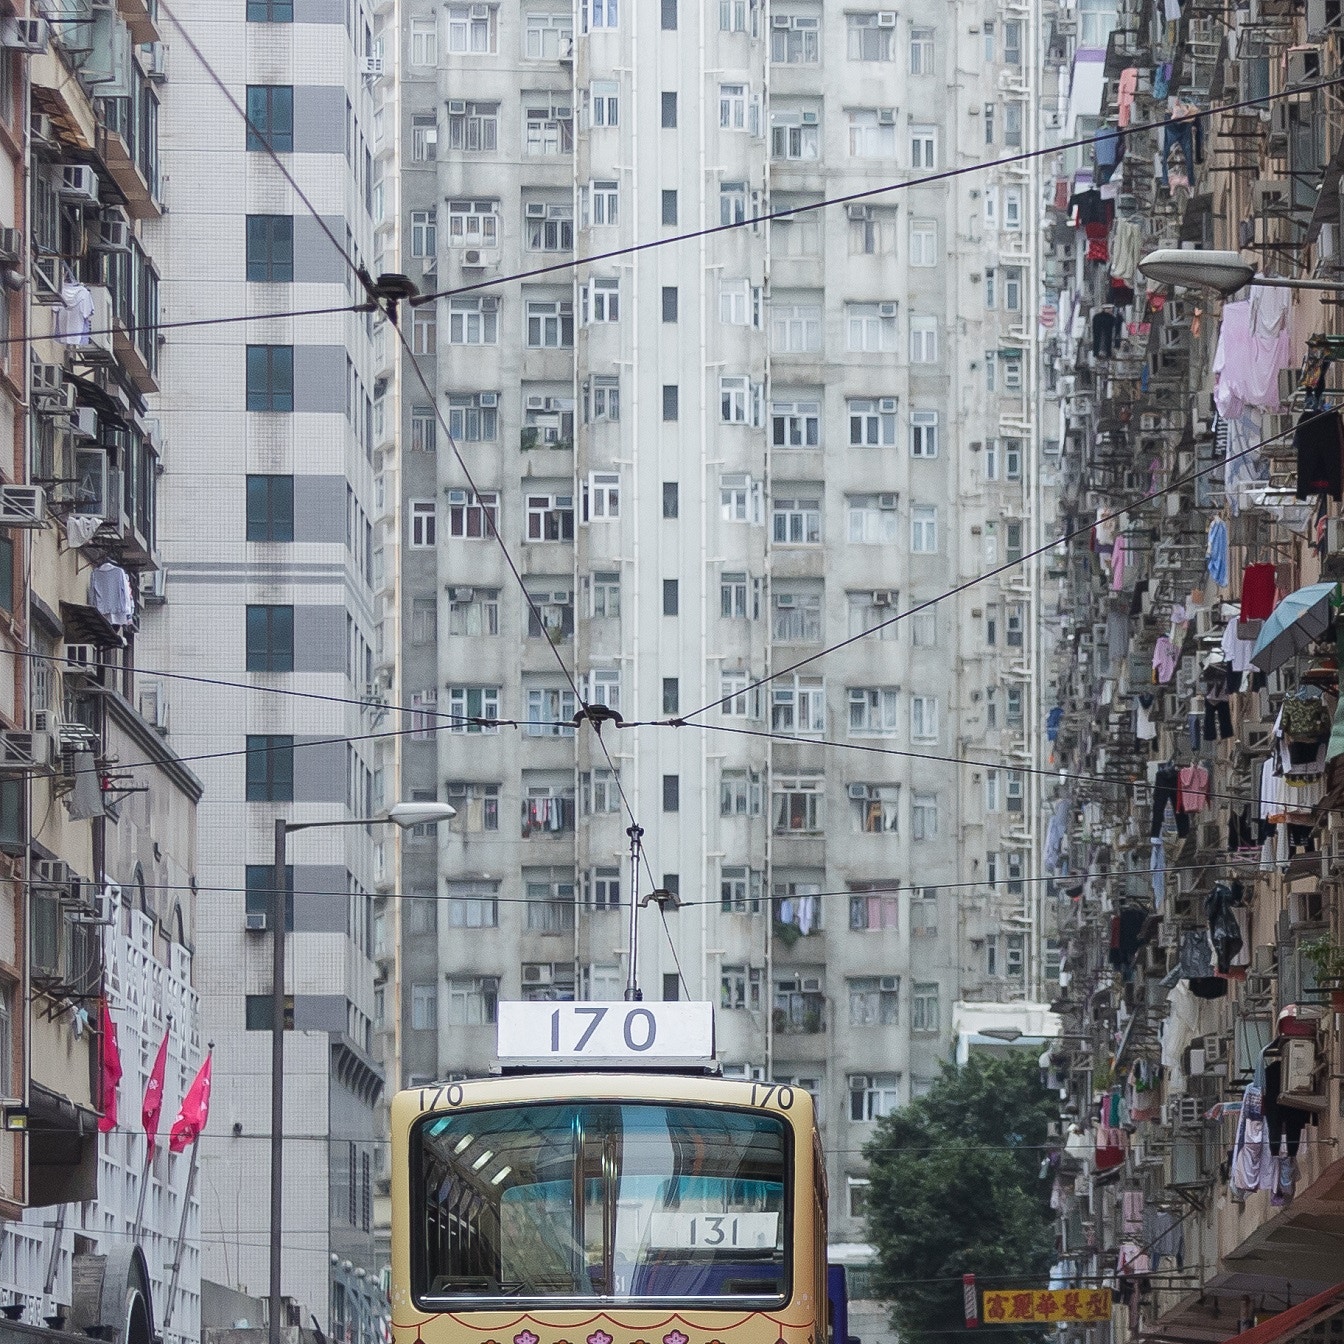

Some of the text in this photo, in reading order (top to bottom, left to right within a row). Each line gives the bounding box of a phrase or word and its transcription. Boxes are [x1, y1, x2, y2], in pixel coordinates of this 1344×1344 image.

[551, 1007, 656, 1051] 170
[420, 1085, 463, 1111] 170
[751, 1084, 794, 1110] 170
[690, 1217, 738, 1246] 131
